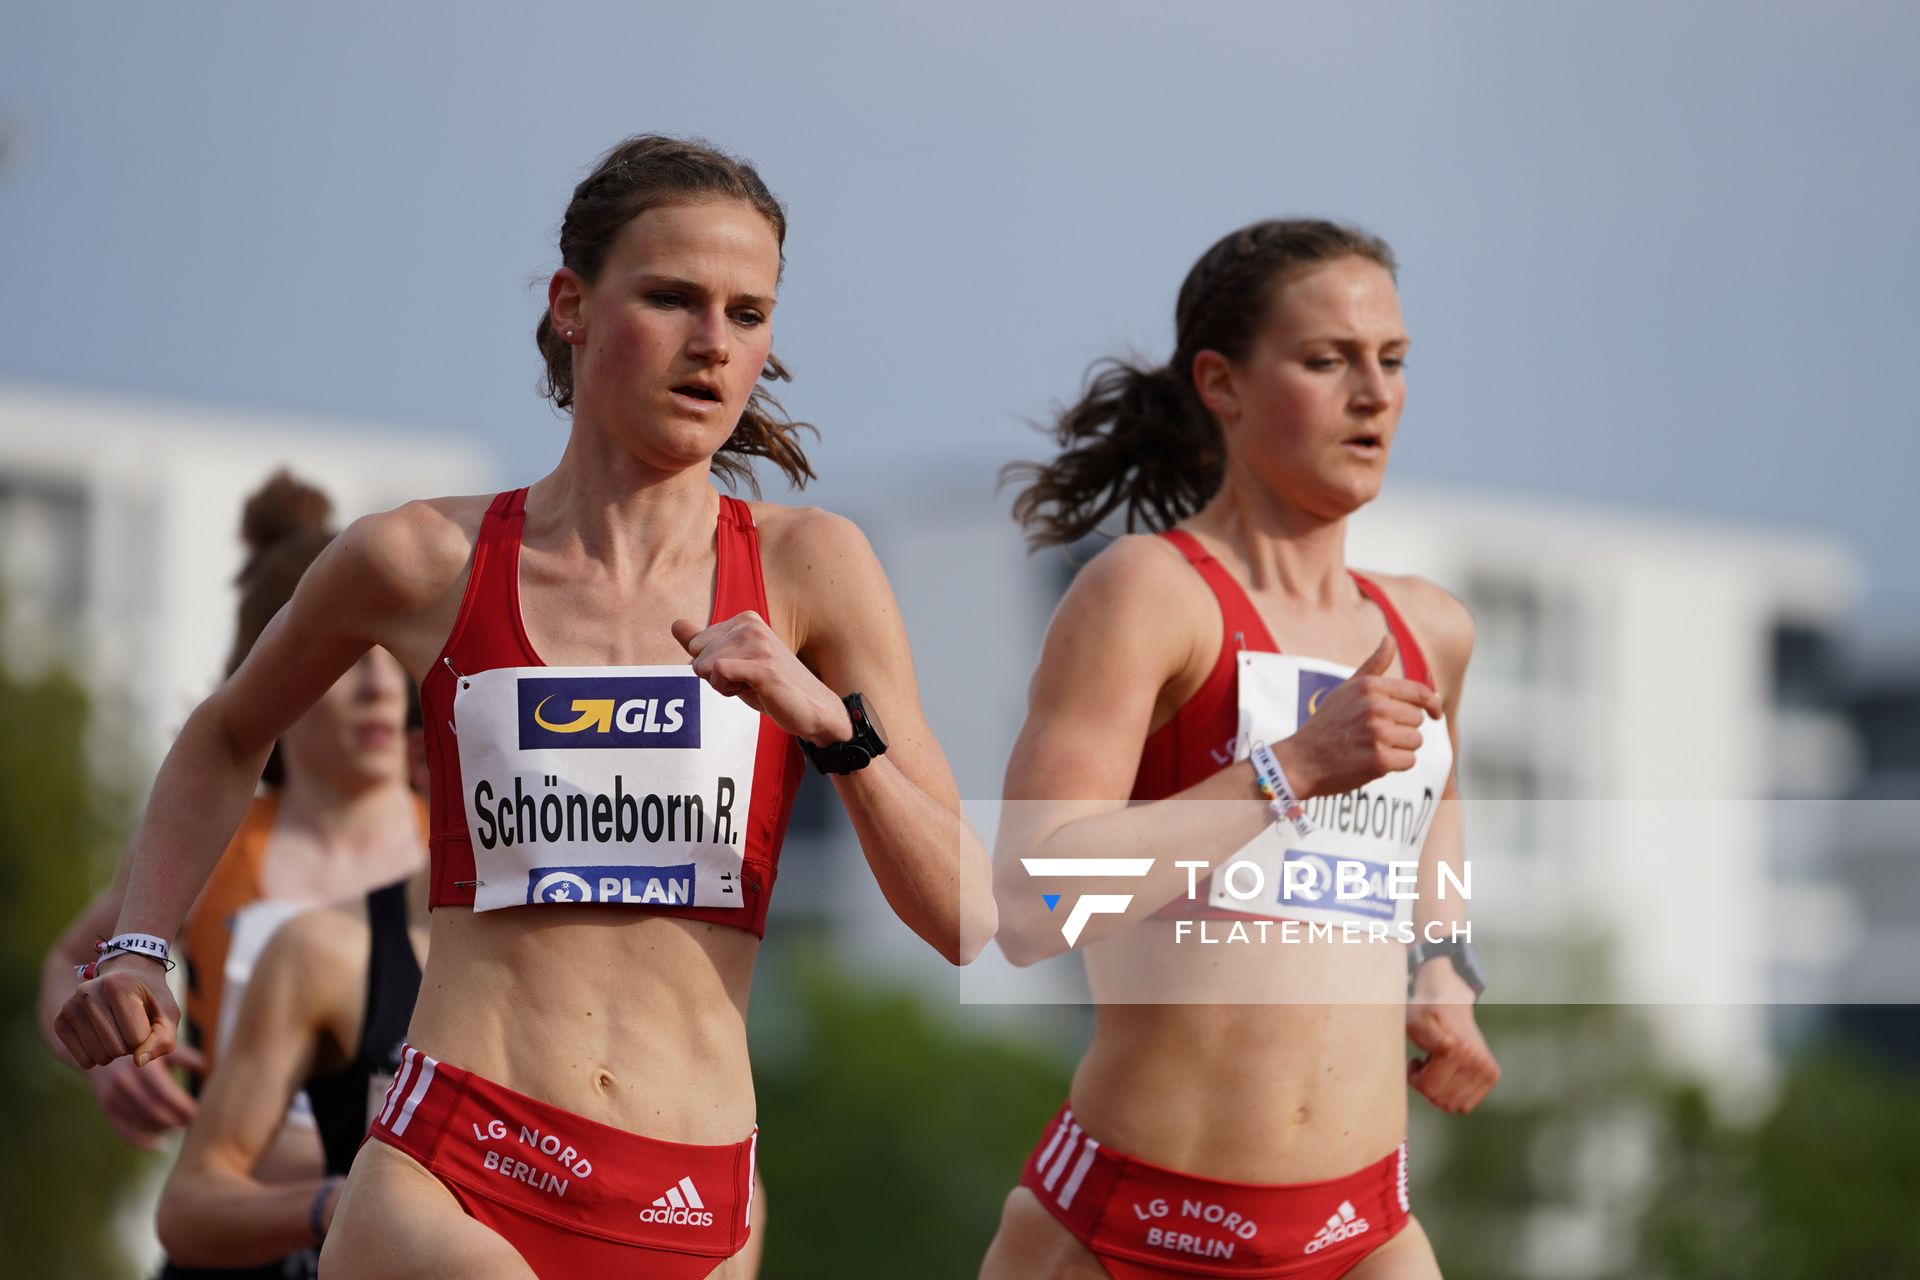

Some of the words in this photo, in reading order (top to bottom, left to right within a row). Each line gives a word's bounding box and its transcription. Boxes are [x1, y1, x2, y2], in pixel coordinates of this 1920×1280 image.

[615, 698, 685, 734] GLS
[474, 775, 704, 850] Schöneborn
[713, 776, 738, 845] R.
[599, 877, 690, 905] PLAN
[472, 1119, 507, 1142] LG
[518, 1125, 593, 1179] NORD
[483, 1150, 570, 1197] BERLIN
[639, 1206, 714, 1227] adidas
[1133, 1198, 1169, 1222] LG
[1181, 1199, 1258, 1241] NORD
[1146, 1227, 1235, 1260] BERLIN
[1303, 1218, 1370, 1256] adidas
